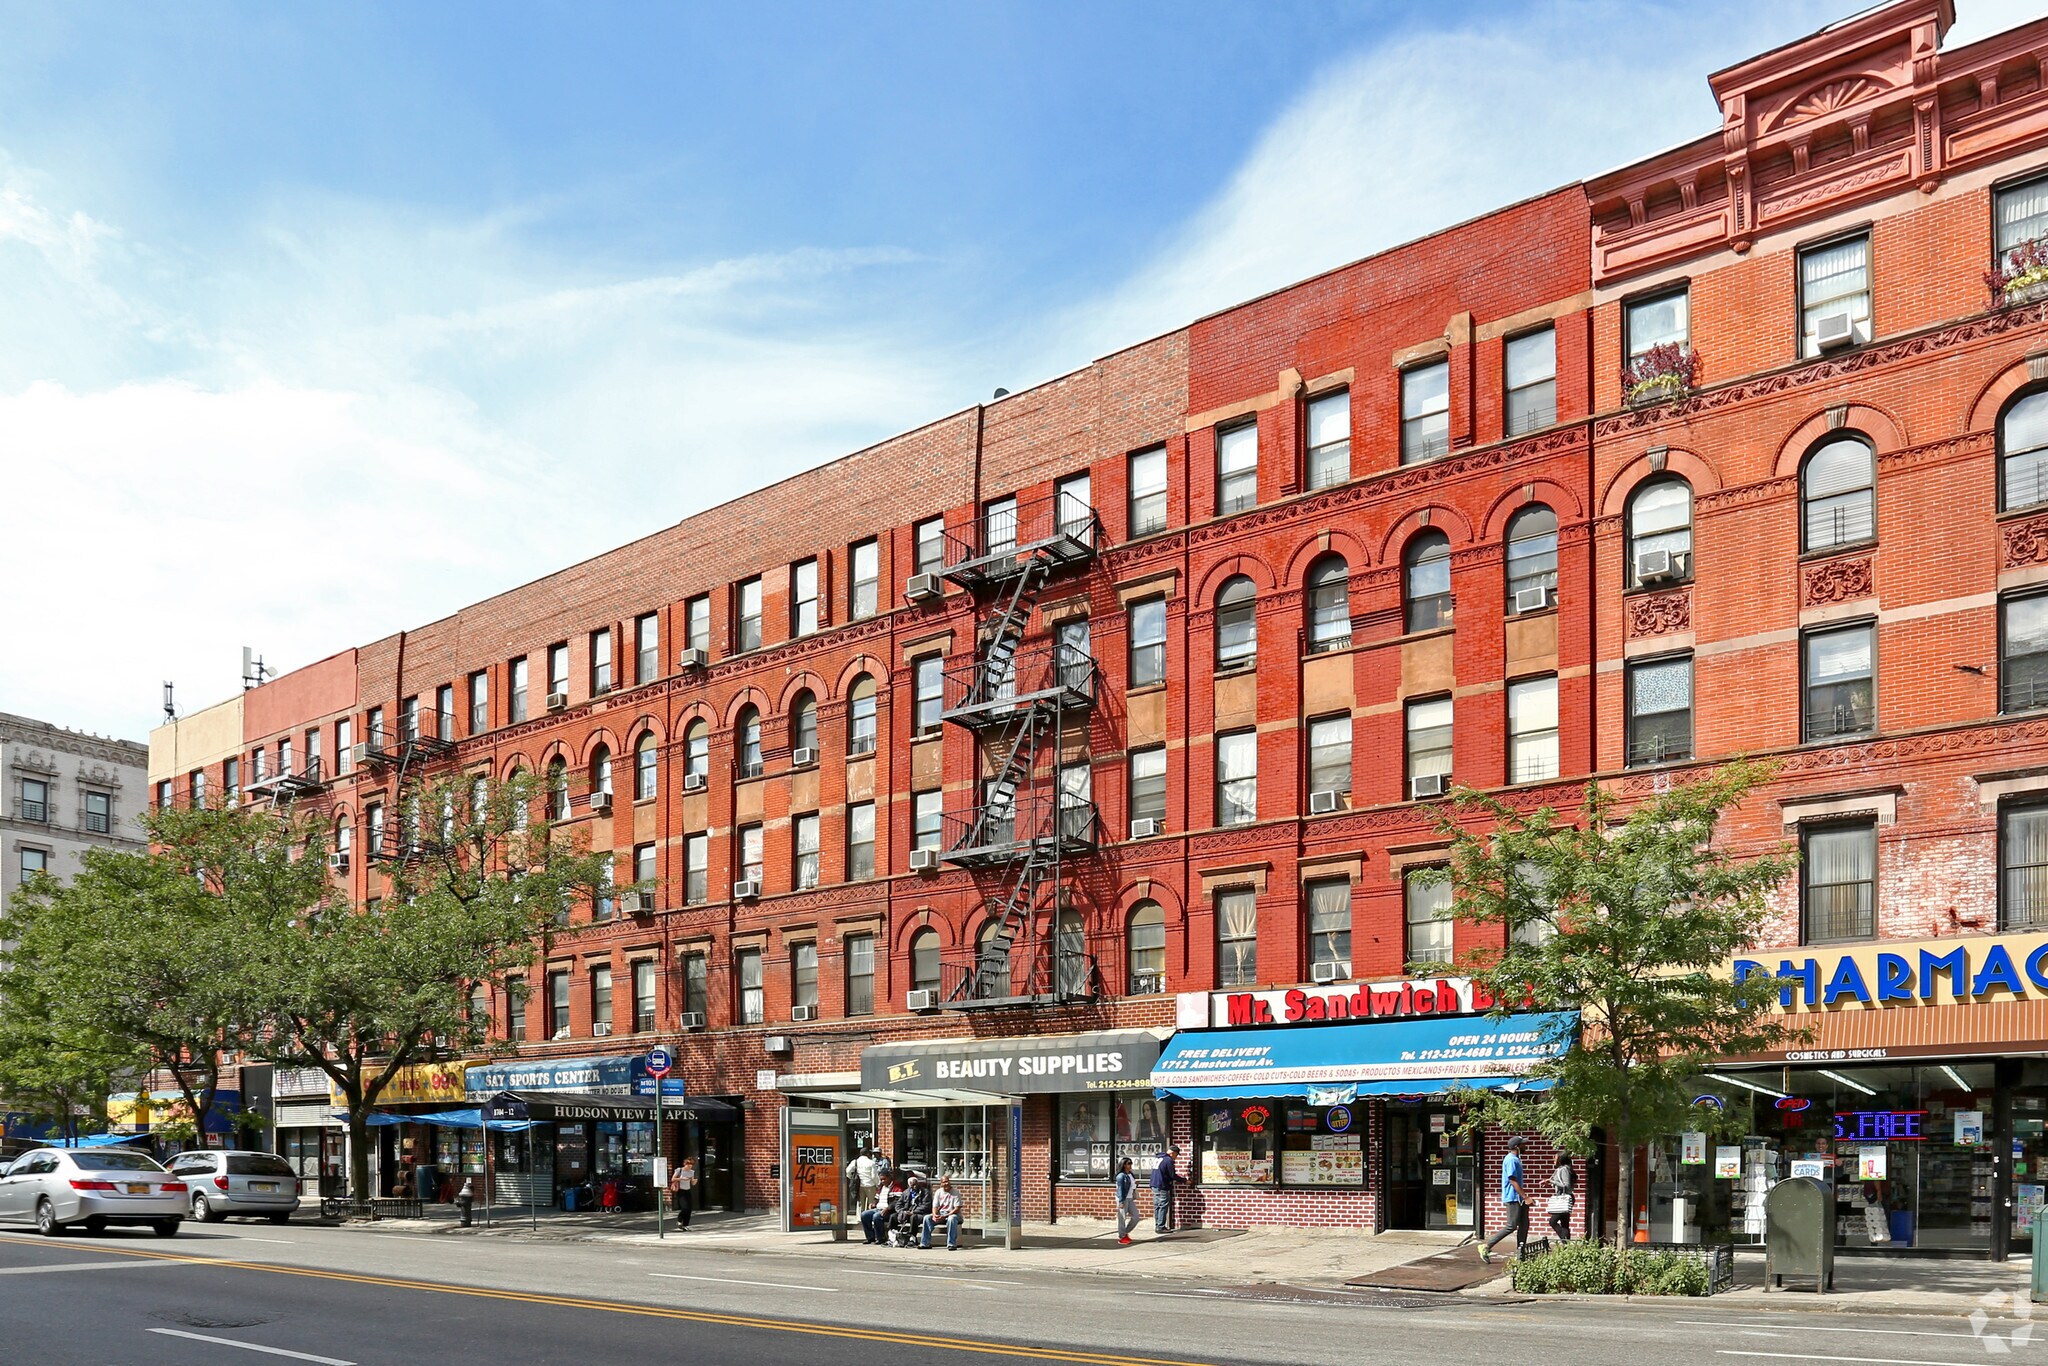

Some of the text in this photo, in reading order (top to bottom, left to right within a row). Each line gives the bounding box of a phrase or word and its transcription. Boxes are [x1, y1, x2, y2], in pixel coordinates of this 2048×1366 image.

[1227, 993, 1273, 1024] Mr.
[1285, 979, 1459, 1021] Sandwich
[1449, 1032, 1539, 1046] OPEN 24 HOURS
[1178, 1046, 1272, 1059] FREE DELIVERY
[1400, 1051, 1416, 1061] Tel.
[1495, 1046, 1504, 1056] &
[1786, 1048, 1887, 1061] COSMETICS AND SURGICALS
[936, 1052, 1123, 1079] BEAUTY SUPPLIES
[1161, 1057, 1274, 1069] 1712 Amsterdam Av.
[485, 1074, 505, 1087] SAY
[509, 1072, 550, 1086] SPORTS
[554, 1069, 600, 1085] CENTER
[889, 1062, 919, 1082] B.T.
[1154, 1075, 1166, 1084] HOT
[1166, 1075, 1171, 1083] &
[1172, 1075, 1187, 1083] COLD
[1189, 1073, 1226, 1083] SANDWICHES
[1228, 1072, 1250, 1081] COFFEE
[1253, 1071, 1269, 1080] COLD
[1271, 1071, 1287, 1080] CUTS
[1288, 1070, 1305, 1079] COLD
[1307, 1069, 1327, 1078] BEERS
[1328, 1069, 1333, 1078] &
[1335, 1068, 1356, 1077] SODAS
[1361, 1065, 1400, 1077] PRODUCTOS
[1402, 1064, 1442, 1075] MEXICANOS
[1444, 1064, 1469, 1074] FRUITS
[1471, 1064, 1477, 1073] &
[1099, 1079, 1152, 1089] 212-234-898
[1777, 1099, 1808, 1109] OPEN
[555, 1105, 609, 1119] HUDSON
[613, 1108, 645, 1120] VIEW
[666, 1110, 698, 1120] APTS.
[1211, 1110, 1229, 1124] Quick
[1217, 1119, 1232, 1131] Draw
[1859, 1113, 1920, 1137] FREE
[797, 1147, 833, 1164] FREE
[795, 1161, 816, 1193] 4G
